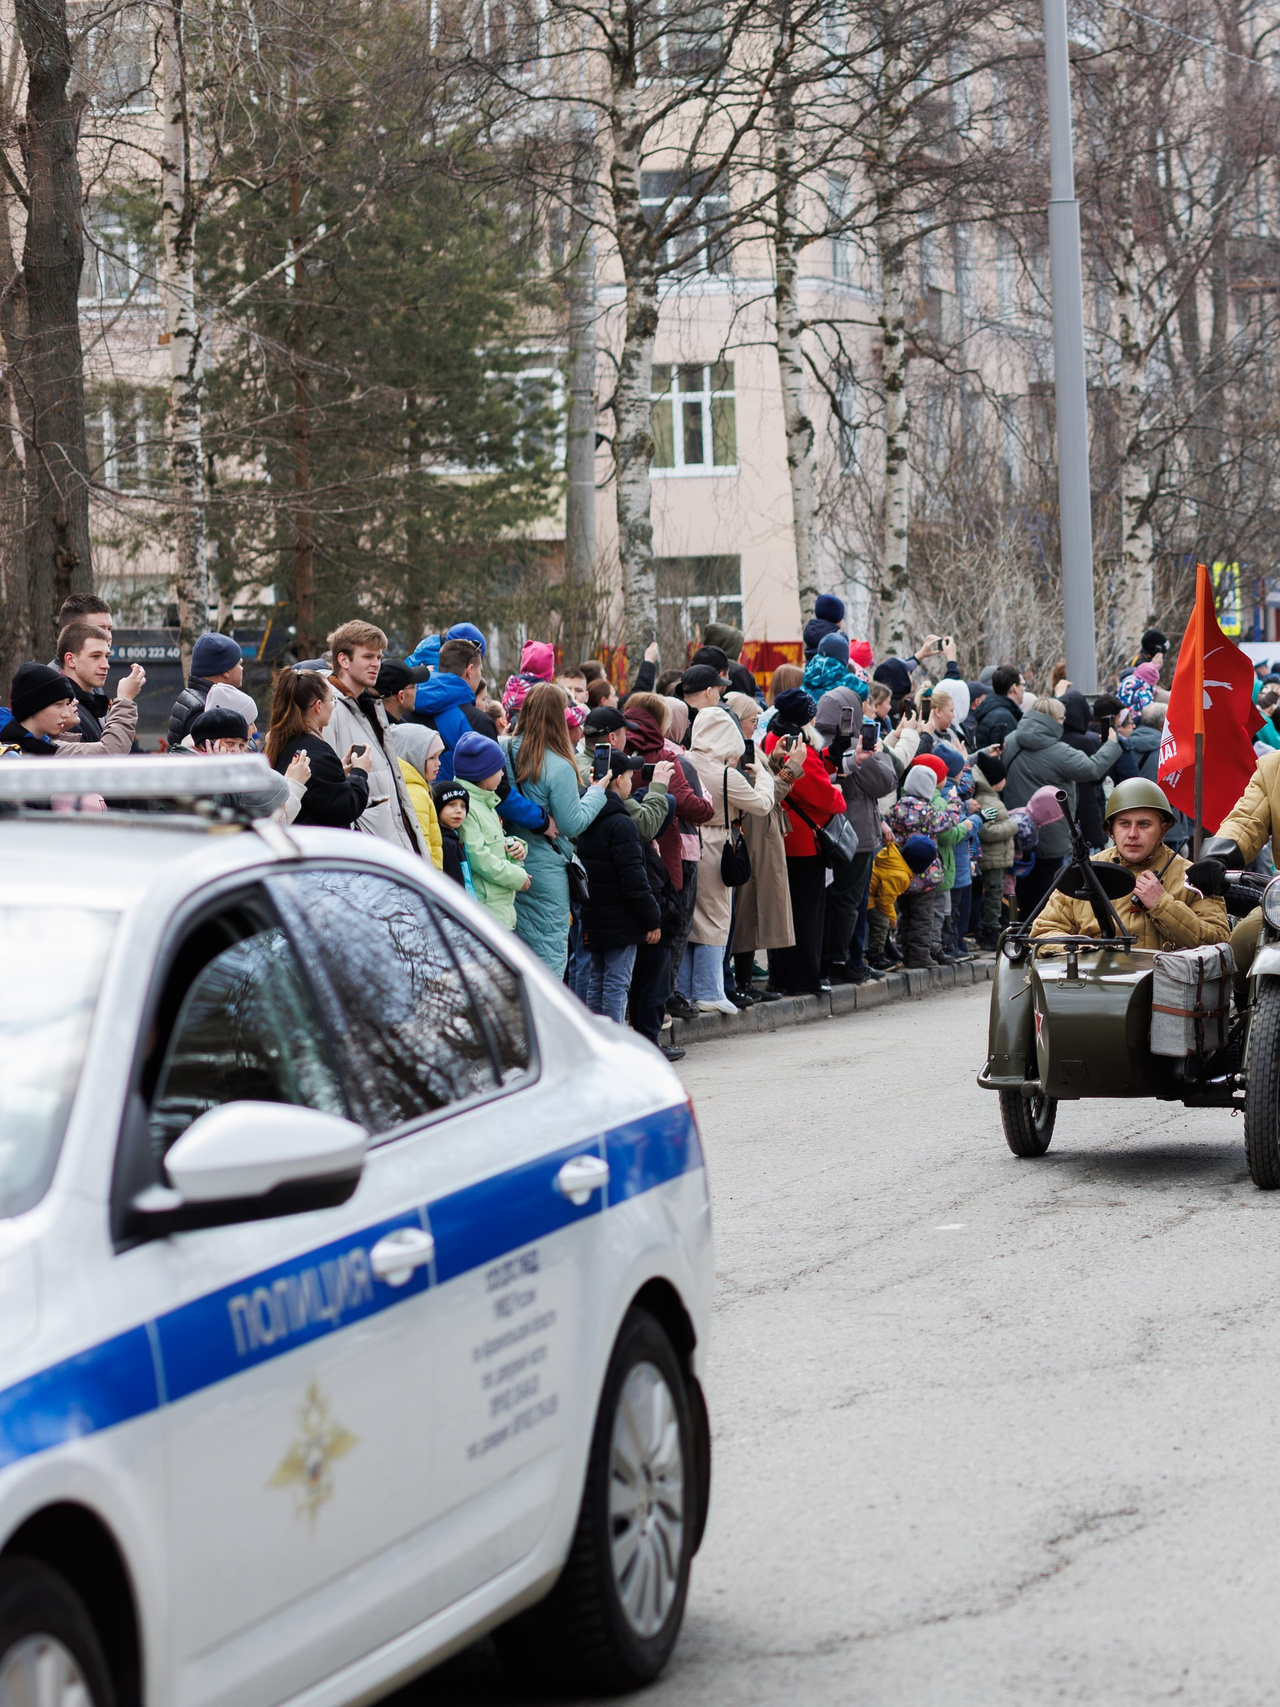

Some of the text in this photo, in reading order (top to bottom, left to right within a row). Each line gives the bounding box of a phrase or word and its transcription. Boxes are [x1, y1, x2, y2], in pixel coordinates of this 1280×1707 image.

[118, 647, 126, 658] 8
[127, 647, 147, 658] 800
[148, 647, 165, 658] 222
[227, 1246, 375, 1358] ПОЛИЦИЯ
